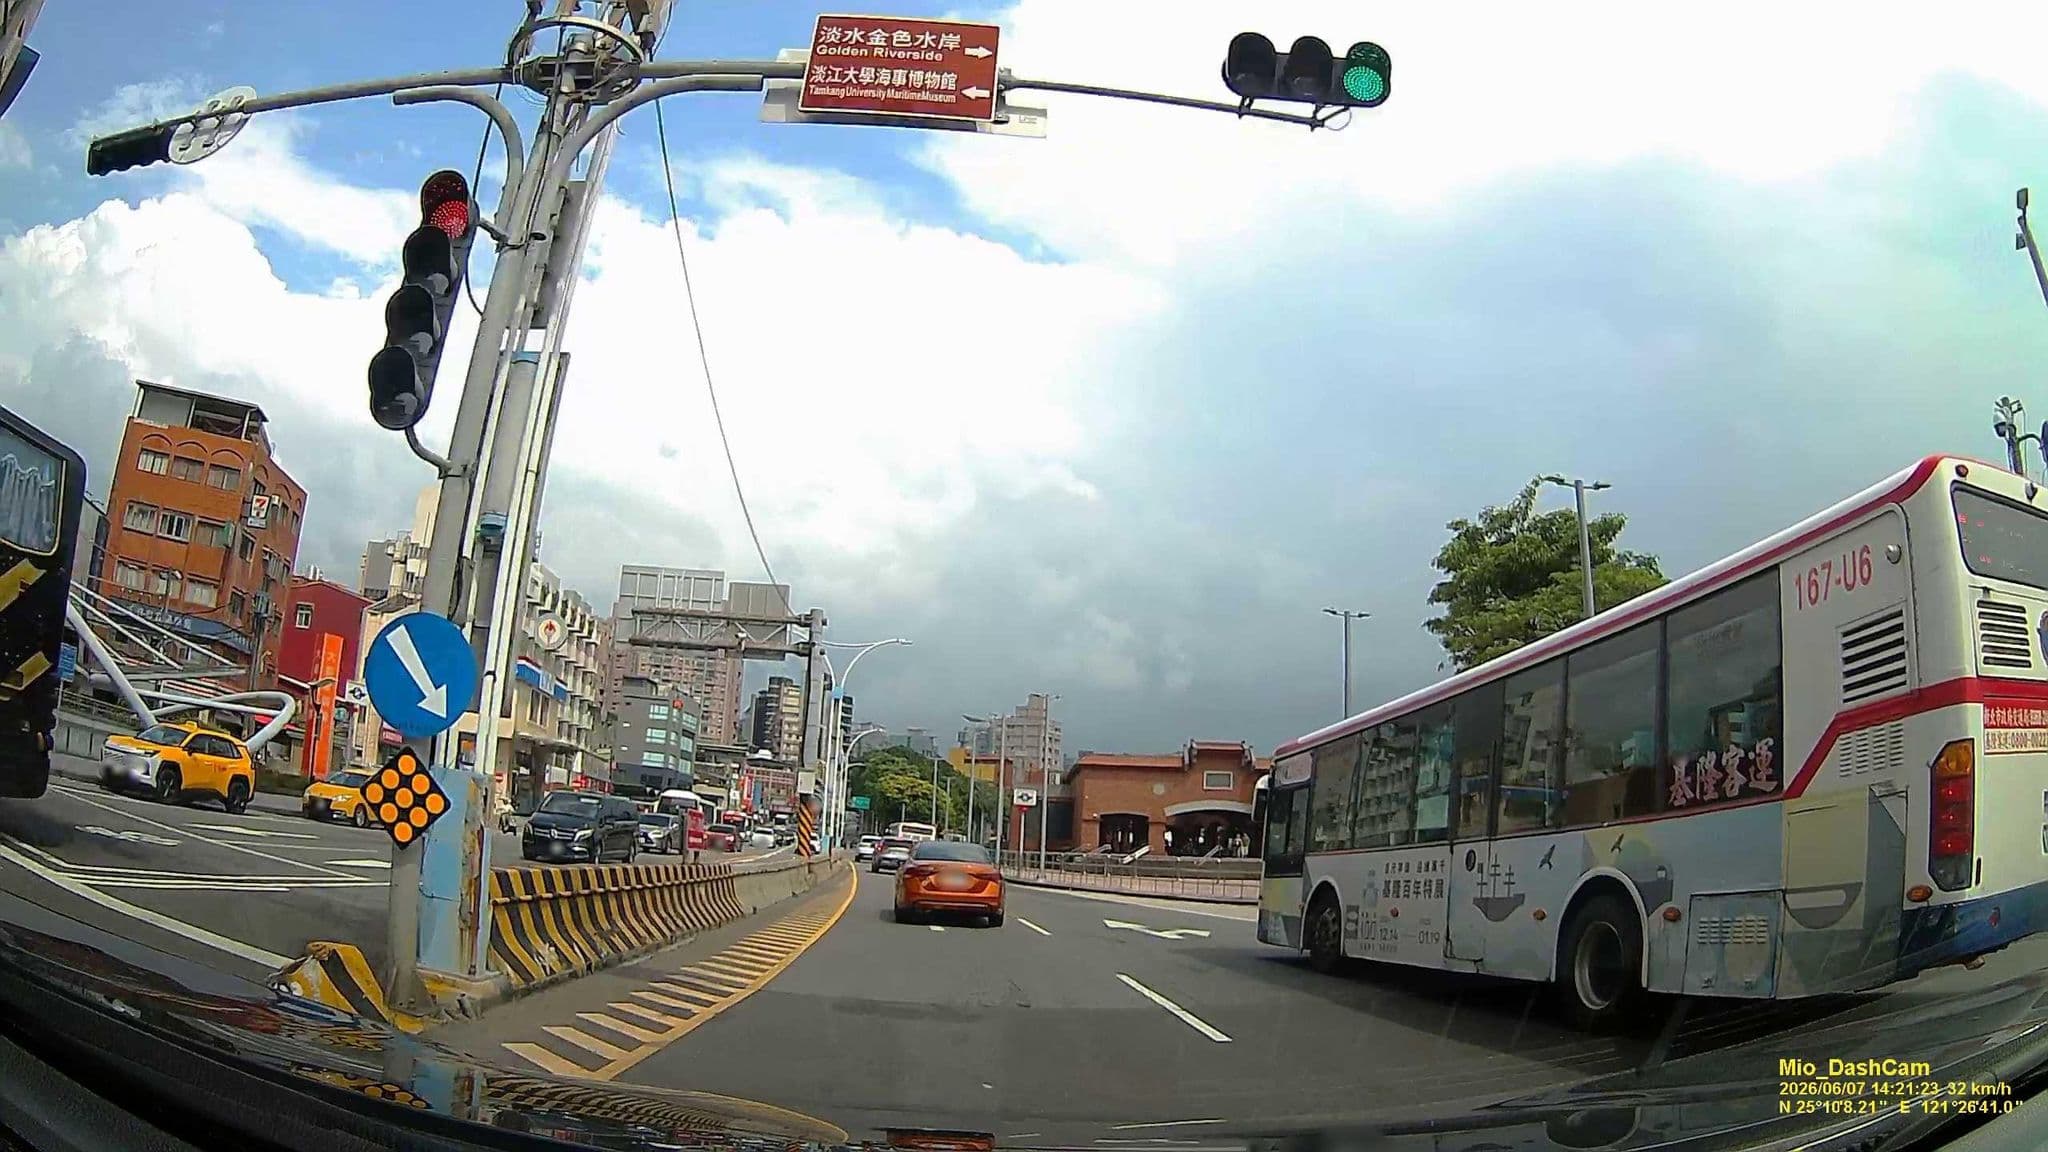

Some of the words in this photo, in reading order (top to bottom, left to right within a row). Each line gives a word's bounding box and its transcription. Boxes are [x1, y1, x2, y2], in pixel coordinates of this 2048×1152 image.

[818, 26, 961, 51] 淡水金色水岸
[816, 44, 869, 57] Golden
[873, 47, 943, 62] Riverside
[809, 65, 957, 90] 淡江大學海事博物館
[809, 85, 845, 99] Tamkang
[846, 88, 886, 101] University
[921, 90, 957, 103] Museum
[1795, 544, 1872, 611] 167-U6
[1669, 738, 1778, 807] 基隆客運
